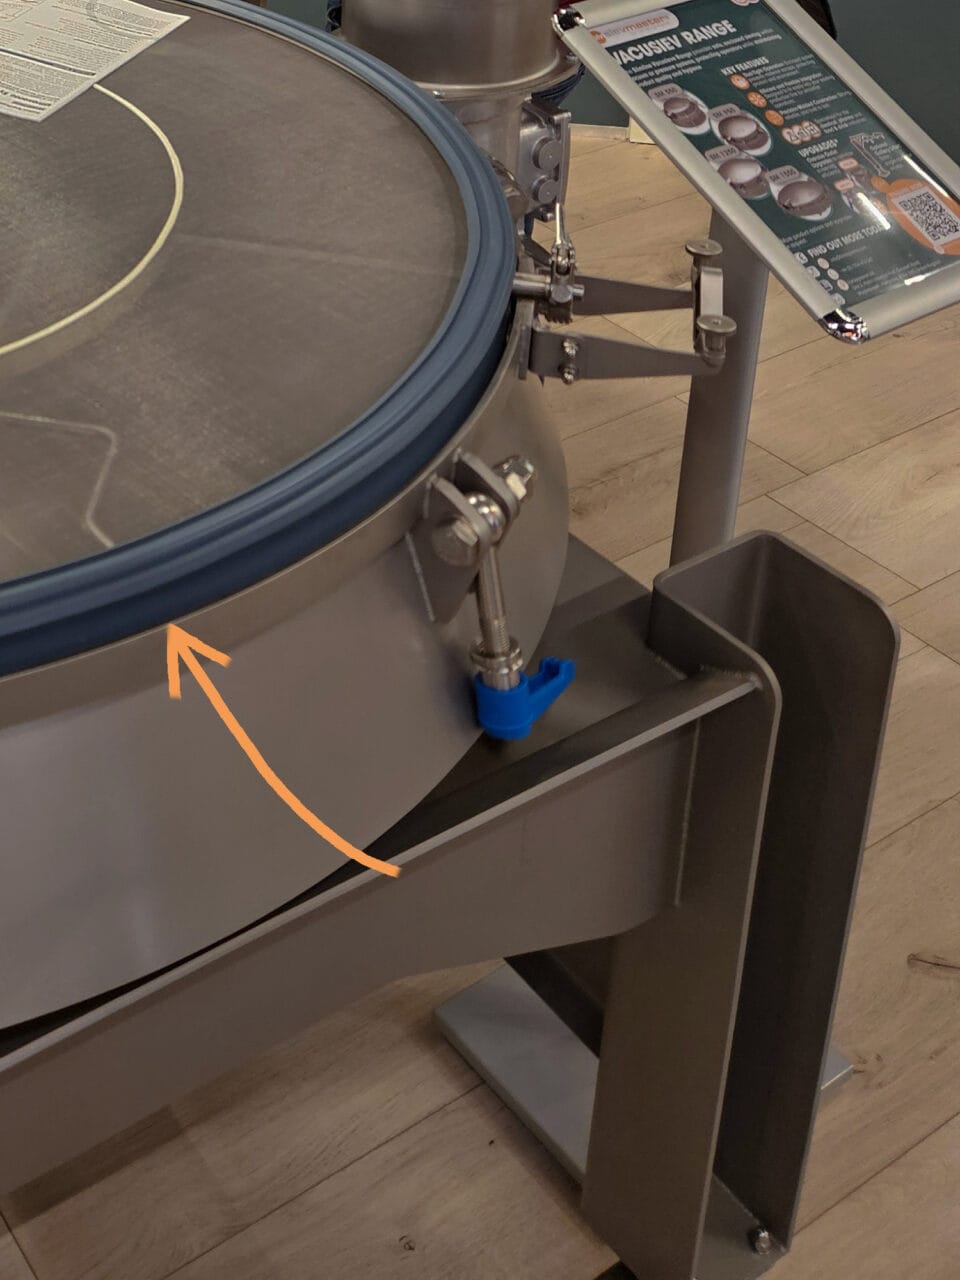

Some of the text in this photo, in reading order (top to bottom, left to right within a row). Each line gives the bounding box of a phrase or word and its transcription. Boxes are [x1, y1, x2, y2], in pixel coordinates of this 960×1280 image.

[683, 19, 737, 45] RANGE
[734, 56, 770, 72] FEATURES
[807, 247, 827, 258] FIND
[826, 238, 843, 251] OUT
[841, 231, 864, 245] MORE
